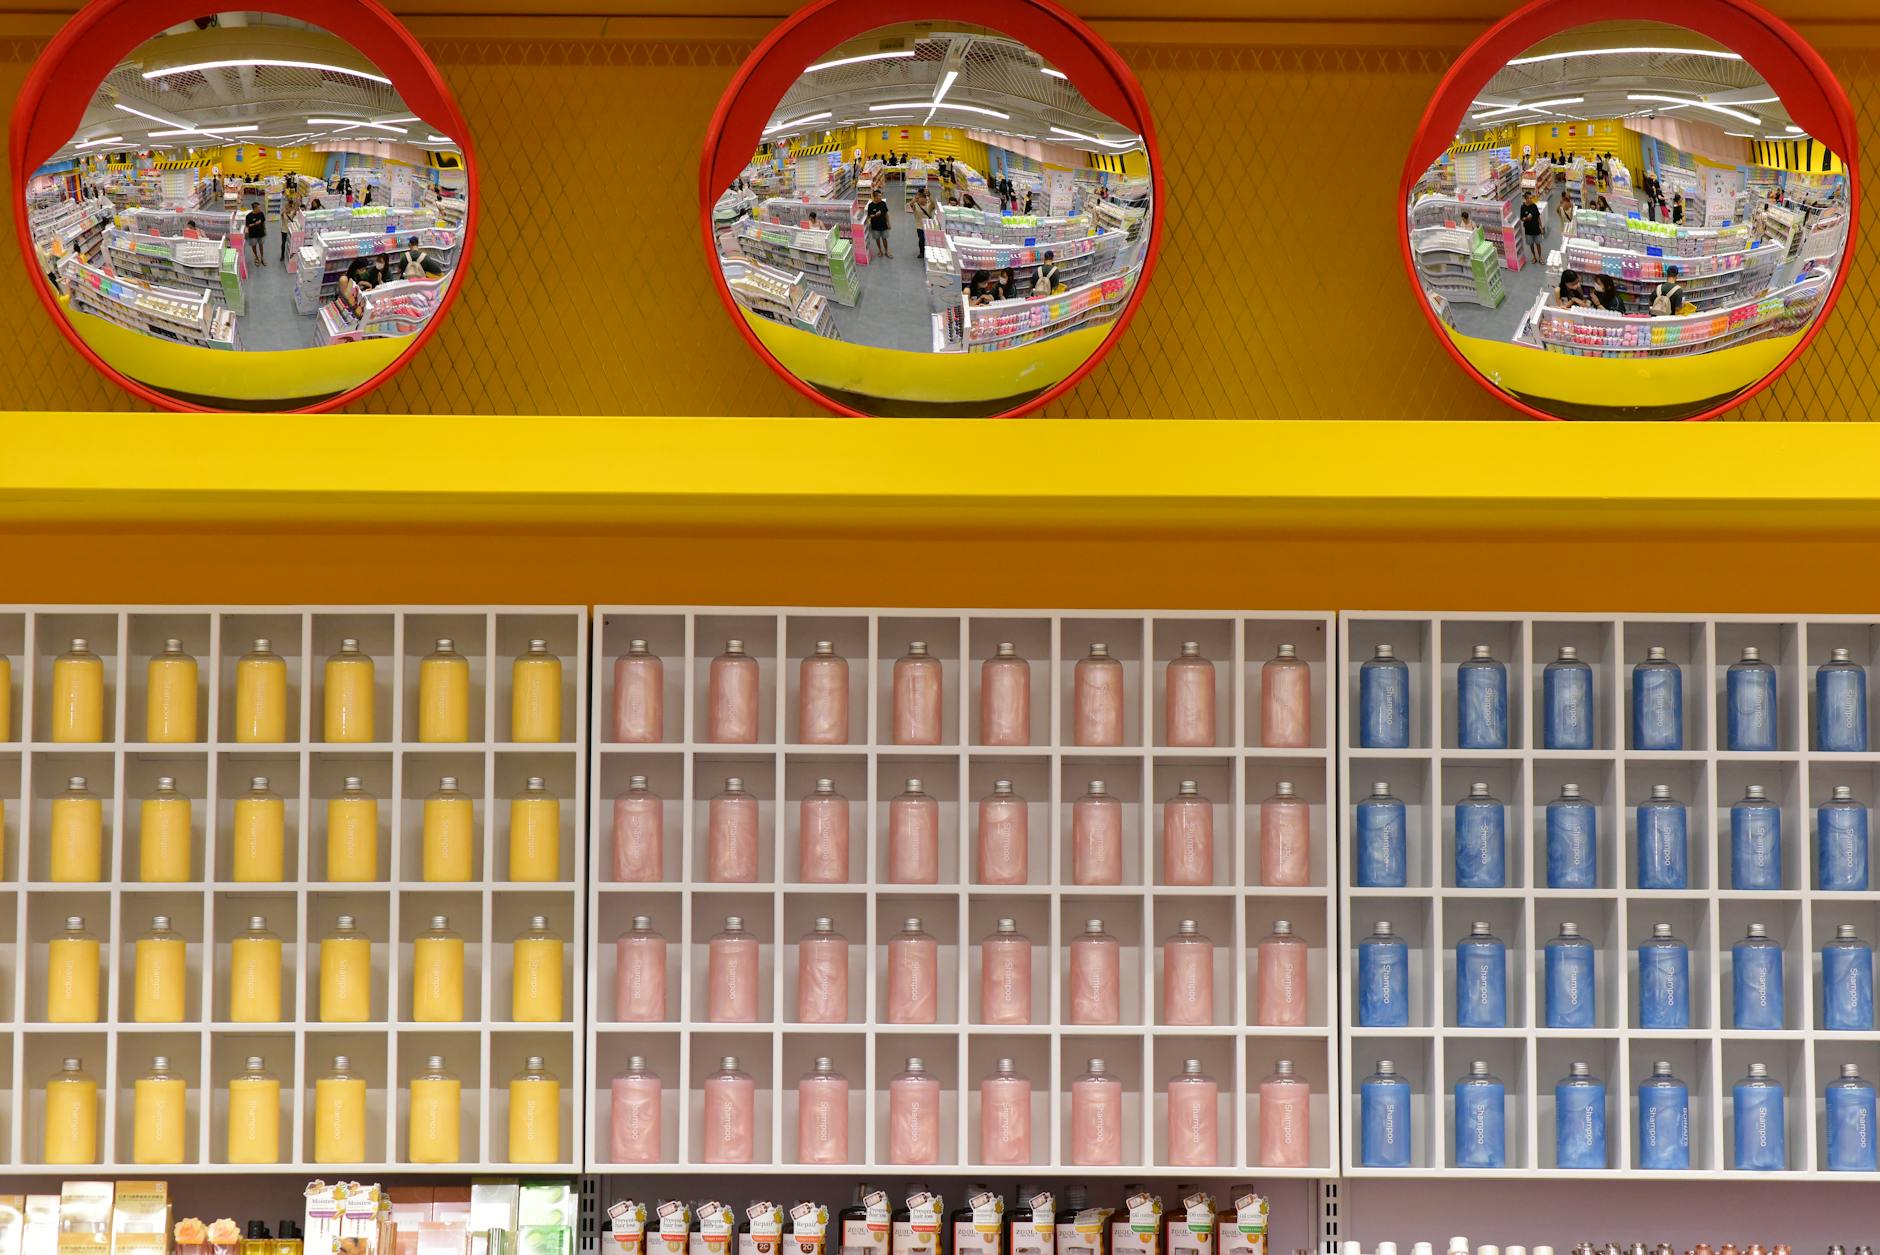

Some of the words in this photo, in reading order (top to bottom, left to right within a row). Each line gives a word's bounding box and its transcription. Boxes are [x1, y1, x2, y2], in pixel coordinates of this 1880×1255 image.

[1384, 686, 1394, 725] Shampoo
[1483, 688, 1492, 726] Shampoo
[1383, 825, 1391, 864] Shampoo
[1480, 825, 1489, 864] Shampoo
[1573, 826, 1581, 864] Shampoo
[1663, 827, 1671, 865] Shampoo
[1757, 828, 1765, 866] Shampoo
[1846, 829, 1854, 867] Shampoo
[727, 960, 737, 1000] Shampoo
[1004, 960, 1013, 1000] Shampoo
[1284, 963, 1293, 1003] Shampoo
[1383, 965, 1392, 1004] Shampoo
[1480, 965, 1488, 1005] Shampoo
[1570, 966, 1578, 1005] Shampoo
[1666, 967, 1674, 1006] Shampoo
[1759, 967, 1768, 1006] Shampoo
[1850, 968, 1858, 1007] Shampoo
[723, 1102, 732, 1141] Shampoo
[819, 1102, 828, 1140] Shampoo
[910, 1102, 919, 1141] Shampoo
[1000, 1103, 1009, 1142] Shampoo
[1096, 1103, 1104, 1142] Shampoo
[1191, 1104, 1200, 1143] Shampoo
[1283, 1104, 1293, 1144] Shampoo
[1386, 1104, 1394, 1144] Shampoo
[1476, 1105, 1485, 1144] Shampoo
[1585, 1106, 1593, 1146] Shampoo
[1648, 1107, 1656, 1146] Shampoo
[1759, 1107, 1767, 1147] Shampoo
[1859, 1108, 1867, 1148] Shampoo
